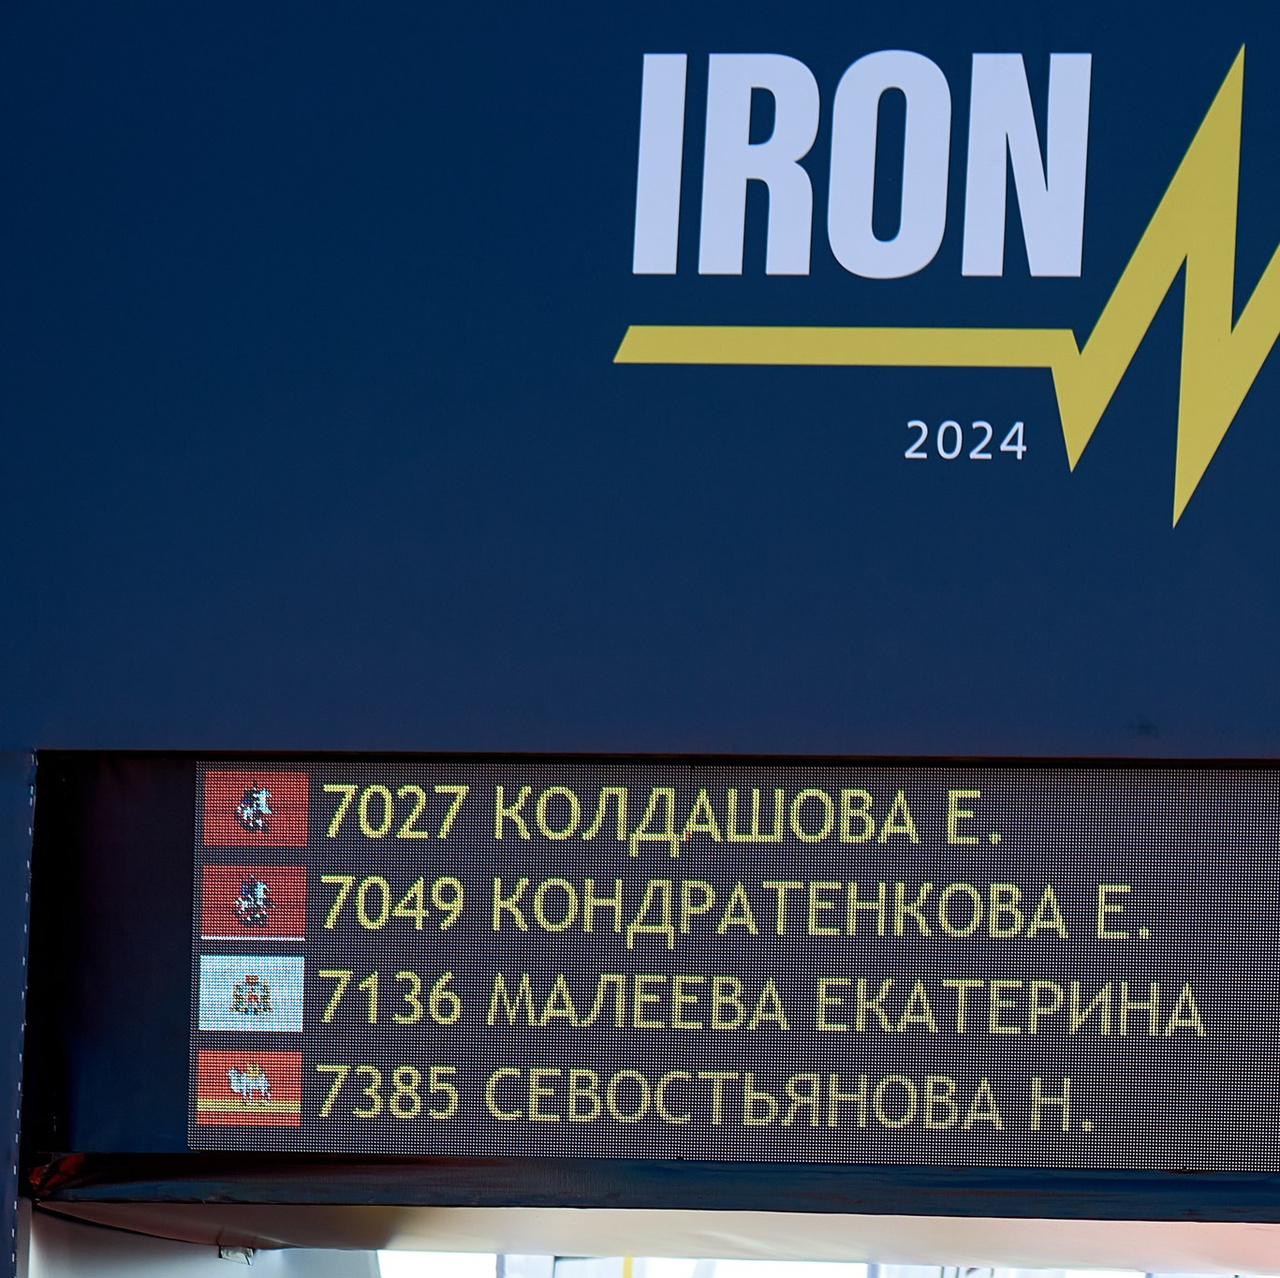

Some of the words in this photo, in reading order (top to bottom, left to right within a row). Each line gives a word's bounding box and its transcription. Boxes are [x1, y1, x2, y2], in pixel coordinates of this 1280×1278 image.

[633, 49, 1093, 279] IRON
[904, 420, 1027, 460] 2024
[323, 784, 469, 840] 7027
[493, 786, 920, 858] КОЛДАШОВА
[320, 874, 466, 931] 7049
[492, 877, 1068, 950] КОНДРАТЕНКОВА
[317, 969, 463, 1027] 7136
[487, 972, 791, 1030] МАЛЕЕВА
[816, 975, 1207, 1038] ЕКАТЕРИНА
[316, 1064, 460, 1120] 7385
[484, 1066, 1005, 1132] СЕВОСТЬЯНОВА
